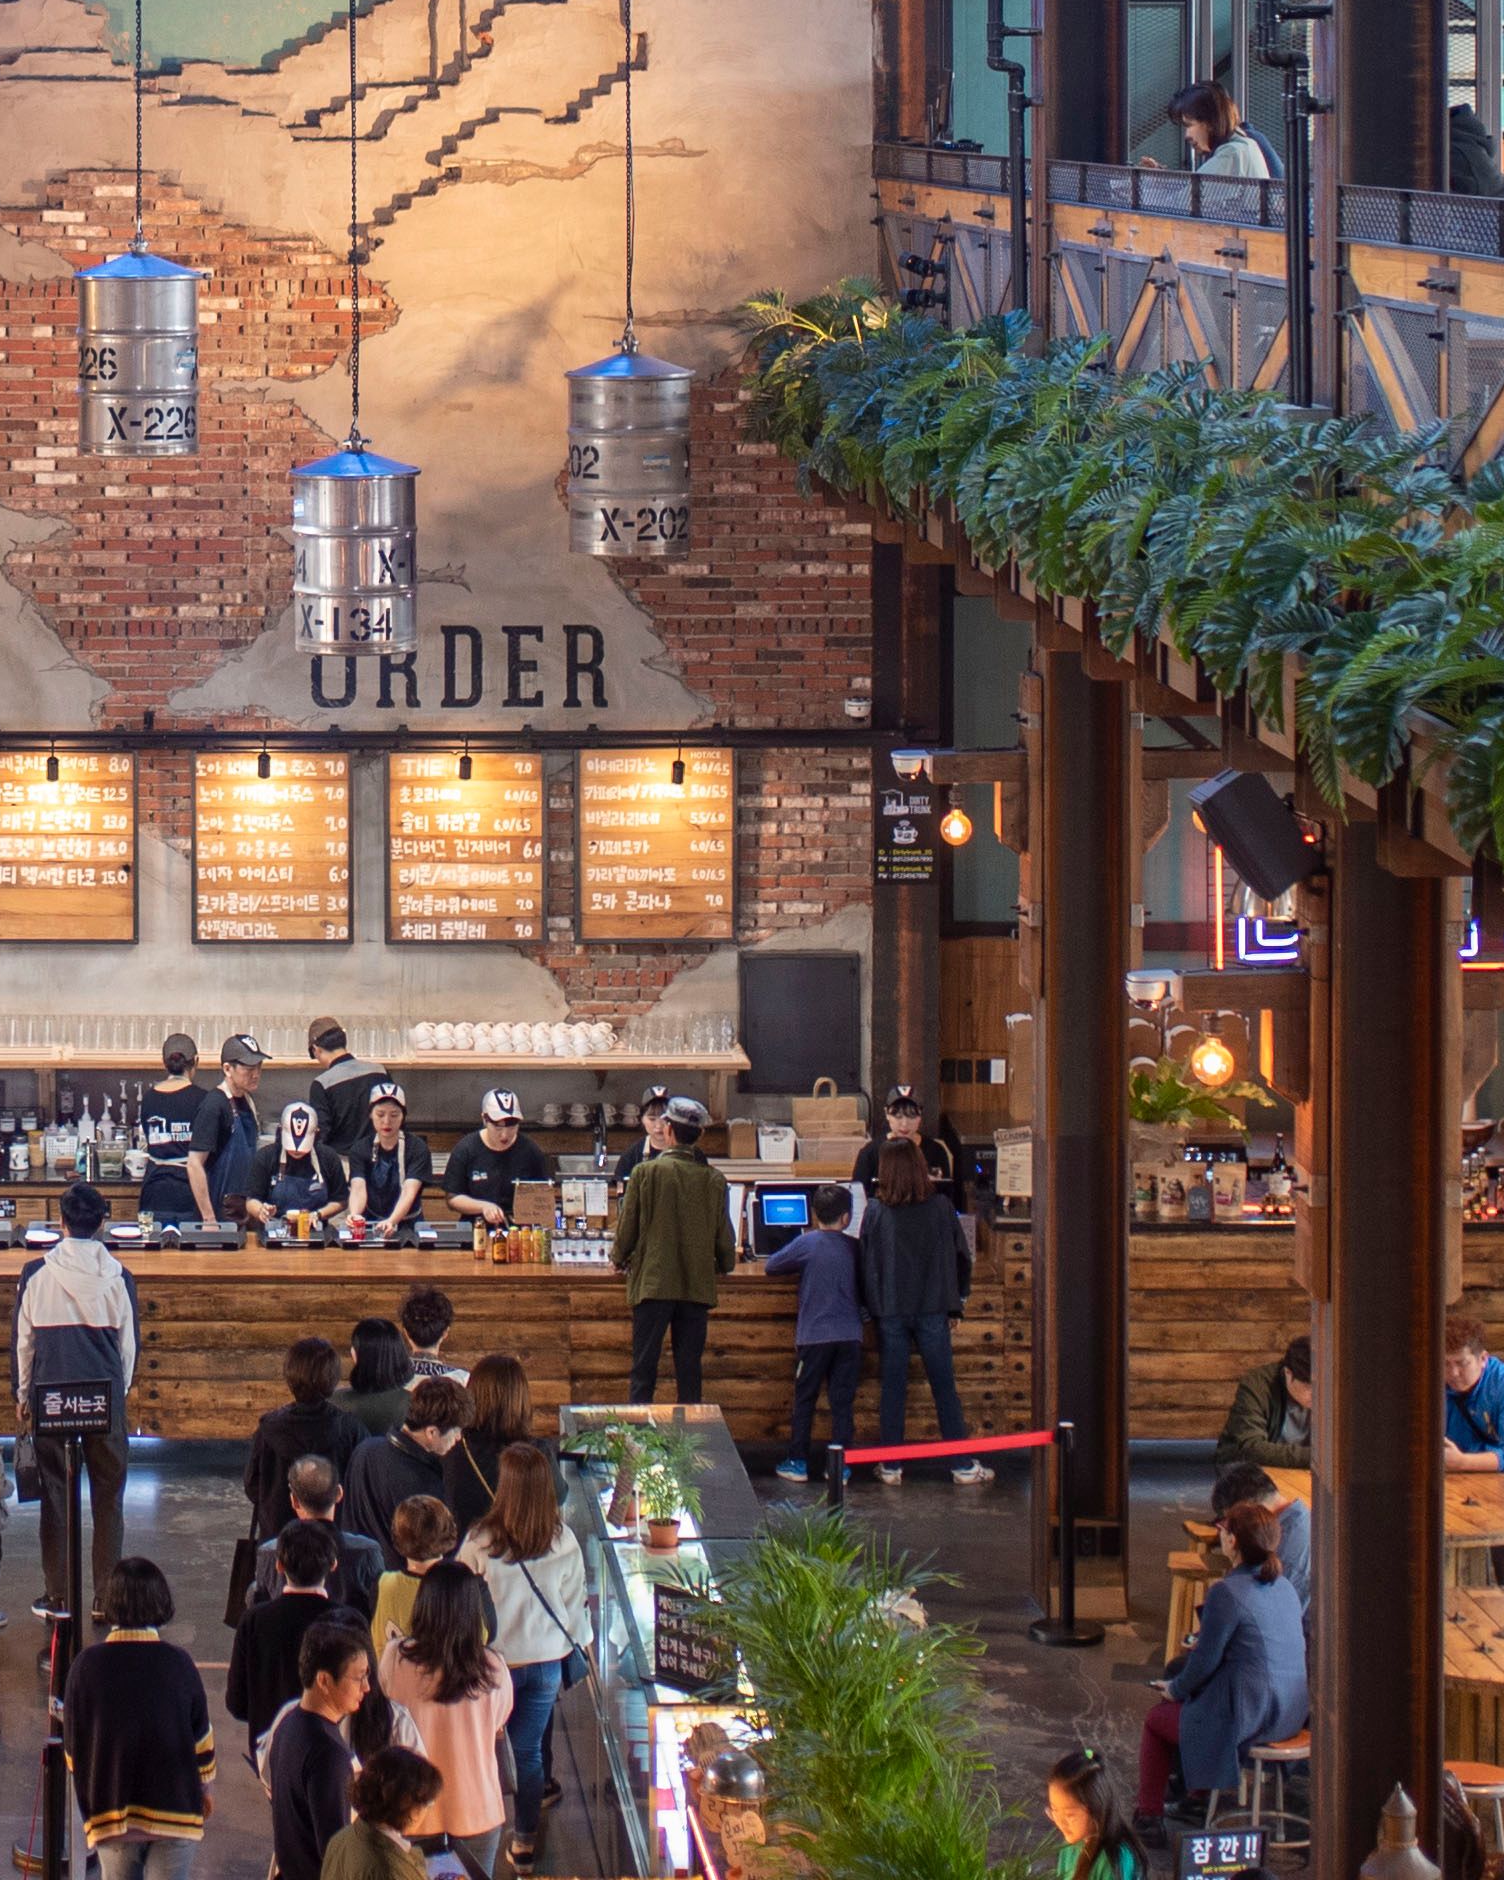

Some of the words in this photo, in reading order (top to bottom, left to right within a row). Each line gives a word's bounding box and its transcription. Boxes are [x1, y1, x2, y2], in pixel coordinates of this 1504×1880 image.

[108, 406, 196, 440] X-226
[601, 506, 688, 541] X-202
[301, 604, 392, 642] X-134
[311, 624, 608, 708] ORDER
[109, 756, 130, 773] 8.0
[325, 761, 345, 776] 7.0
[515, 762, 532, 775] 7.0
[103, 787, 128, 801] 12.5
[325, 786, 345, 801] 7.0
[325, 816, 347, 831] 7.0
[325, 842, 347, 856] 7.0
[522, 841, 542, 858] 6.0
[67, 868, 96, 886] 타코
[101, 870, 128, 884] 15.0
[238, 866, 293, 882] 아이스티
[328, 866, 348, 882] 6.0
[514, 870, 533, 883] 7.0
[327, 896, 348, 911] 3.0
[515, 899, 534, 911] 7.0
[590, 893, 618, 910] 모카
[705, 894, 724, 907] 7.0
[326, 924, 348, 940] 3.0
[515, 924, 533, 938] 7.0
